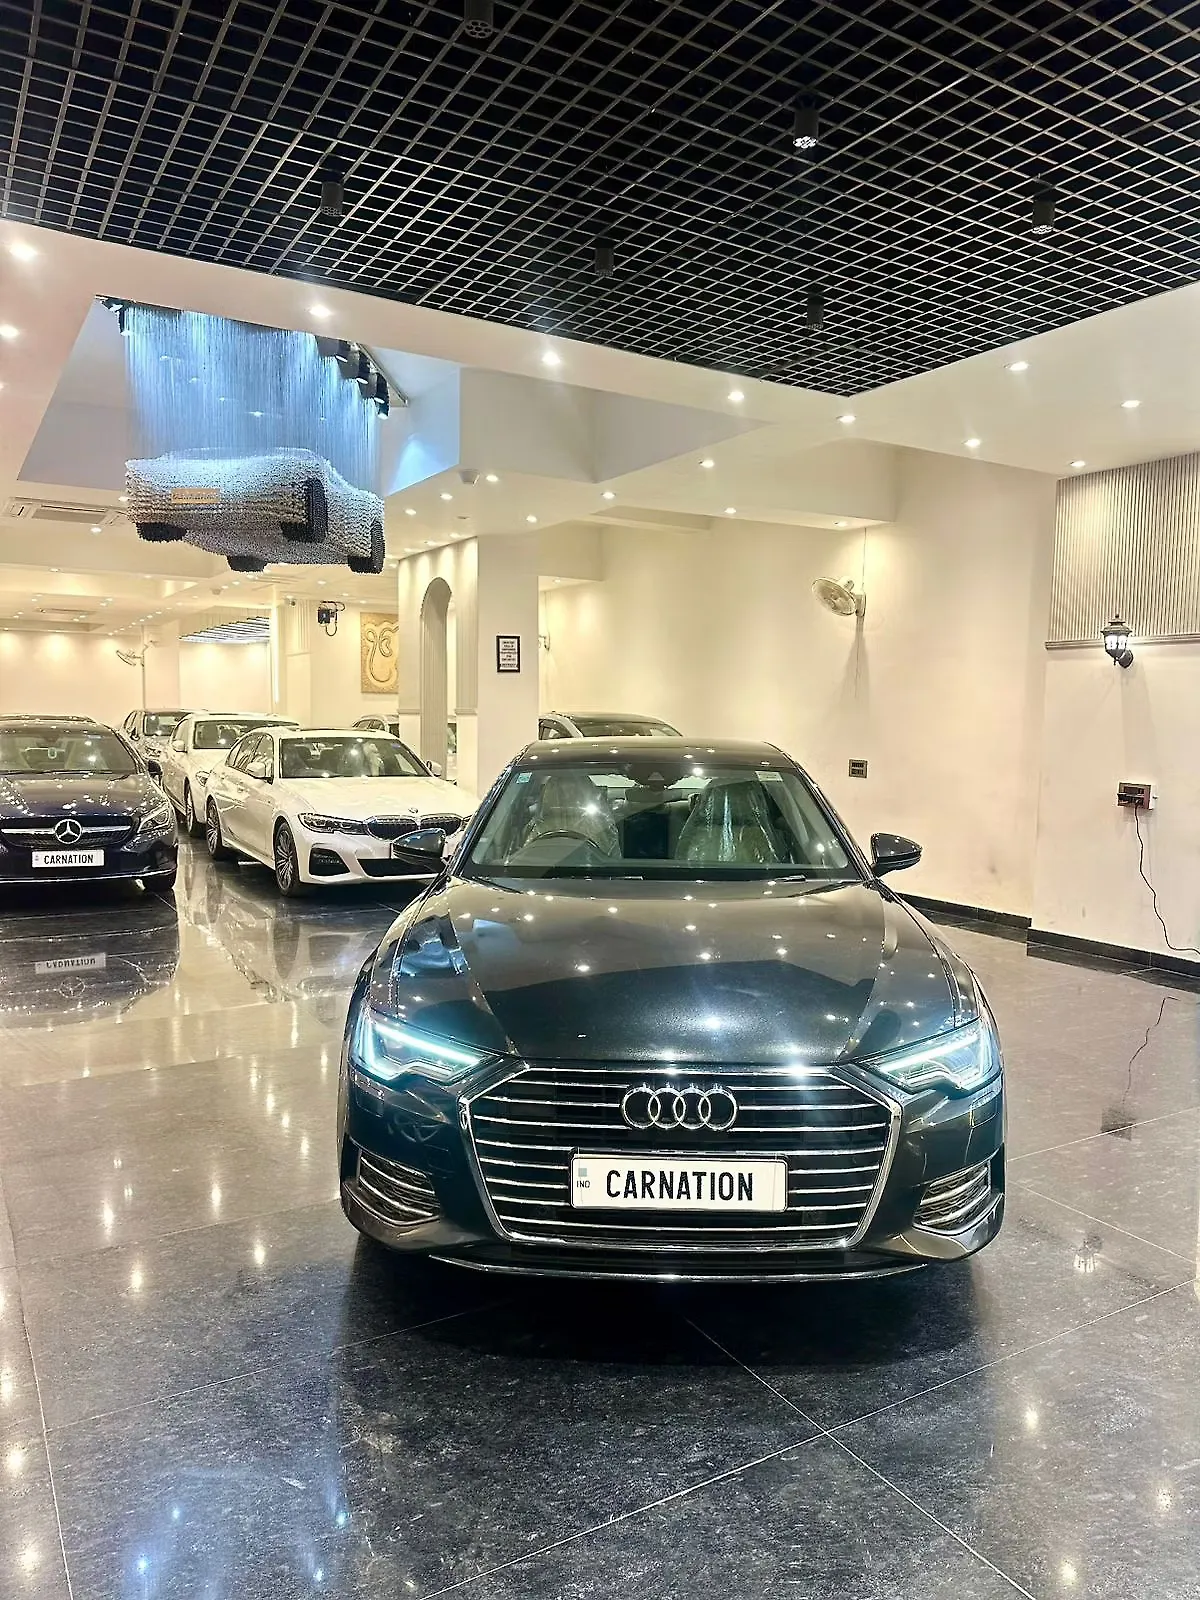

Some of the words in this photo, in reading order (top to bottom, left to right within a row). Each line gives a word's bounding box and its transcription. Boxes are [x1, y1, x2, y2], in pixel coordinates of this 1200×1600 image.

[44, 854, 94, 864] CARNATION
[576, 1180, 591, 1189] IND
[606, 1169, 753, 1201] CARNATION
